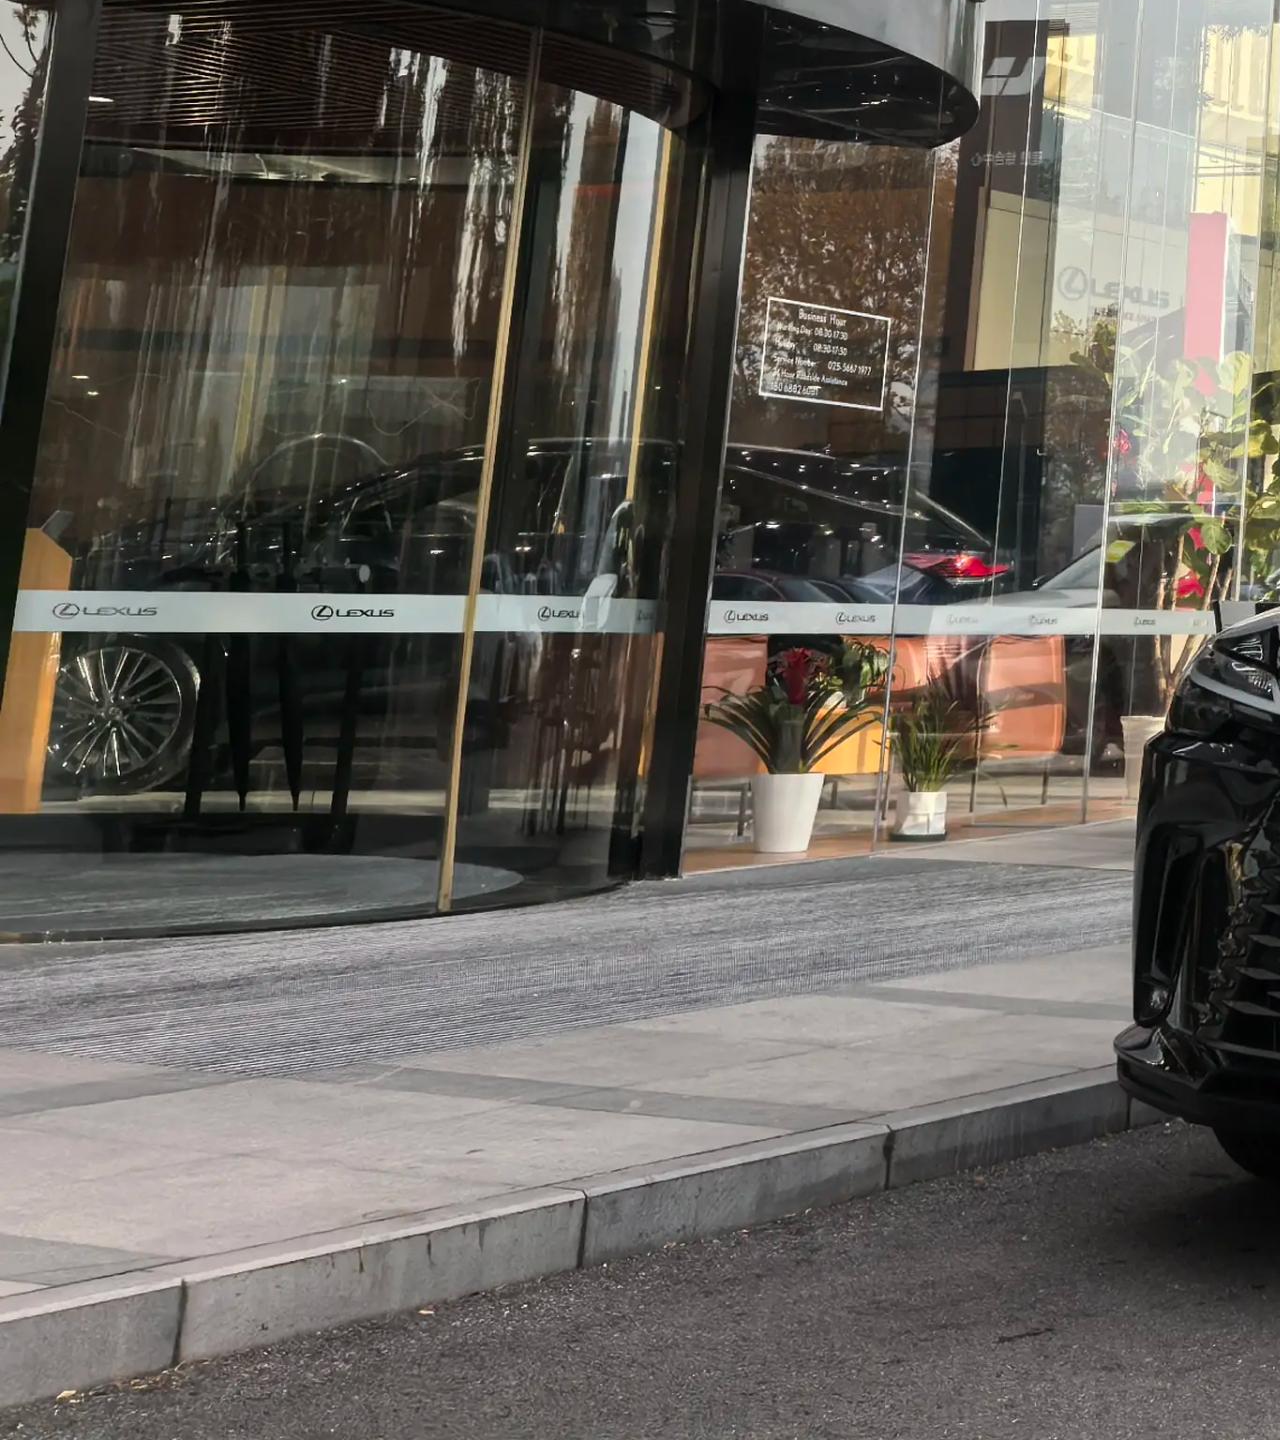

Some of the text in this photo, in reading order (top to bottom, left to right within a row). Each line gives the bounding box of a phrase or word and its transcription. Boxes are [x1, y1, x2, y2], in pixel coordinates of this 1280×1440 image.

[799, 308, 827, 323] Business
[83, 606, 158, 616] LEXUS
[336, 608, 395, 617] LEXUS
[552, 609, 580, 618] LEXU
[736, 613, 769, 621] LEXUS
